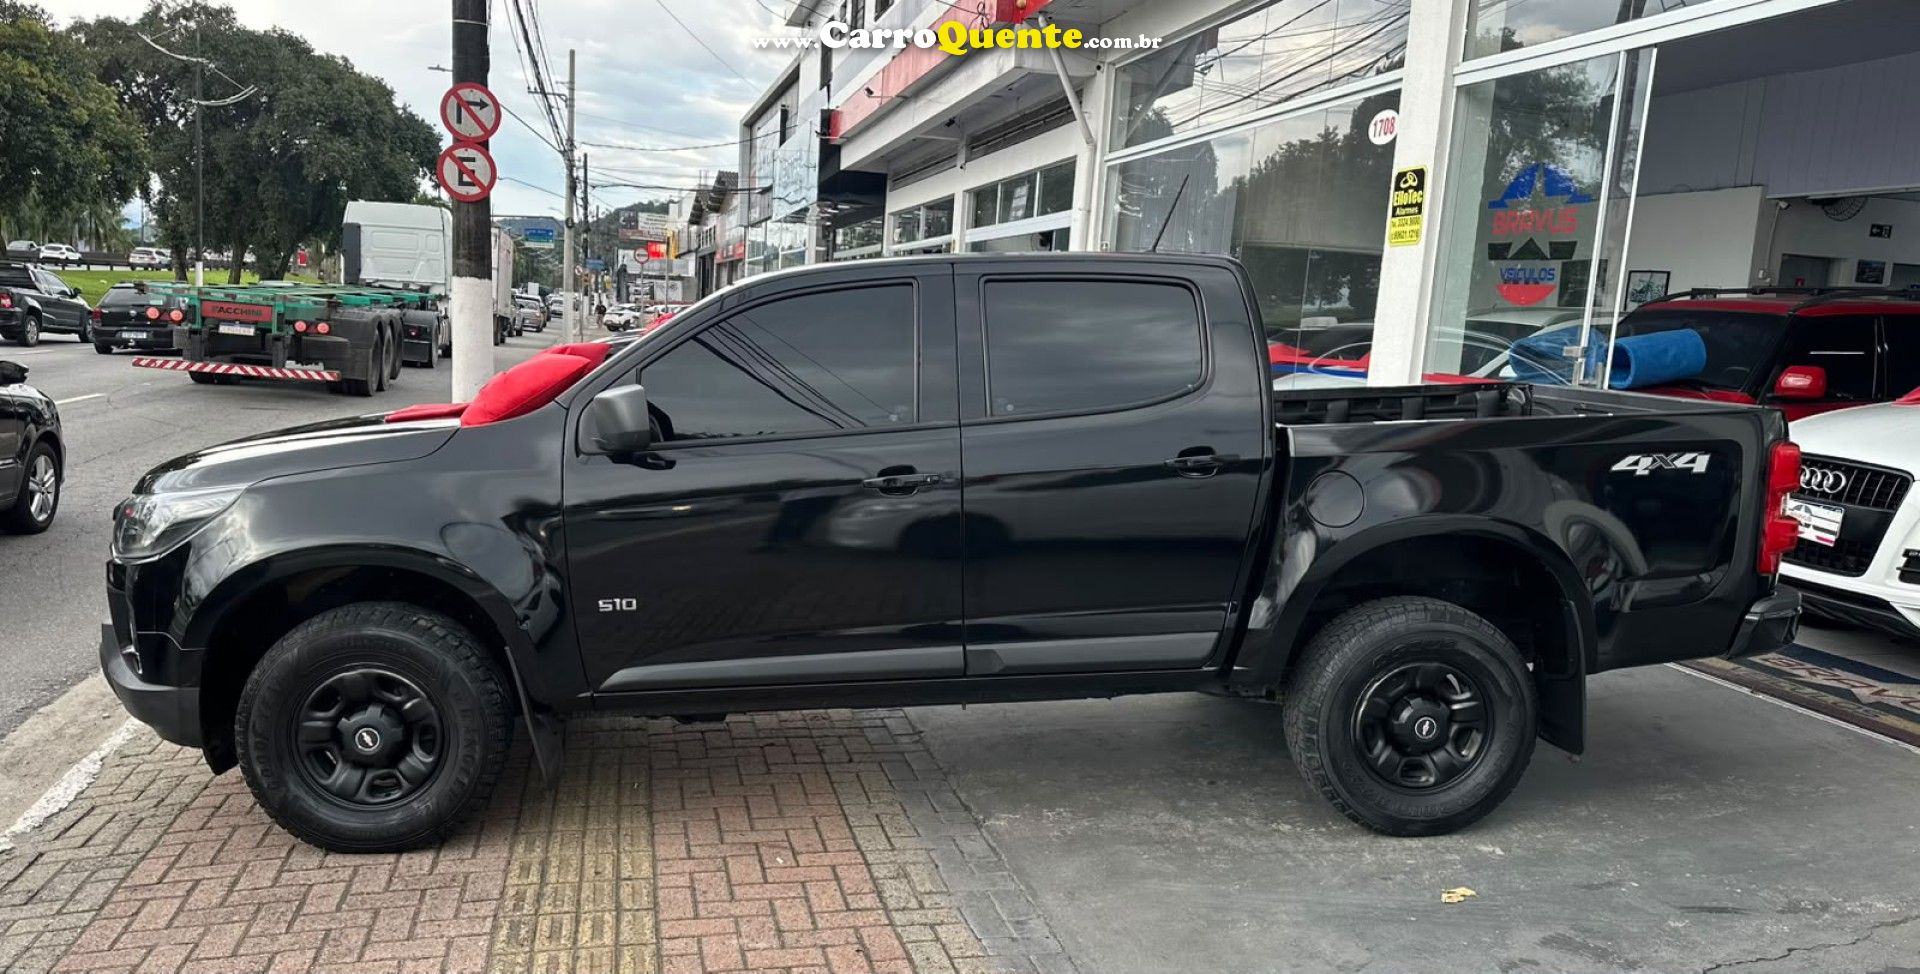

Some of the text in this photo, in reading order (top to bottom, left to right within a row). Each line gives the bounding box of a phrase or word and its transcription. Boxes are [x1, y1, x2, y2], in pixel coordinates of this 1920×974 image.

[1373, 116, 1396, 138] 1708
[1492, 206, 1579, 236] BRAVUS
[1500, 267, 1556, 281] VEICULOS
[598, 598, 637, 612] S10
